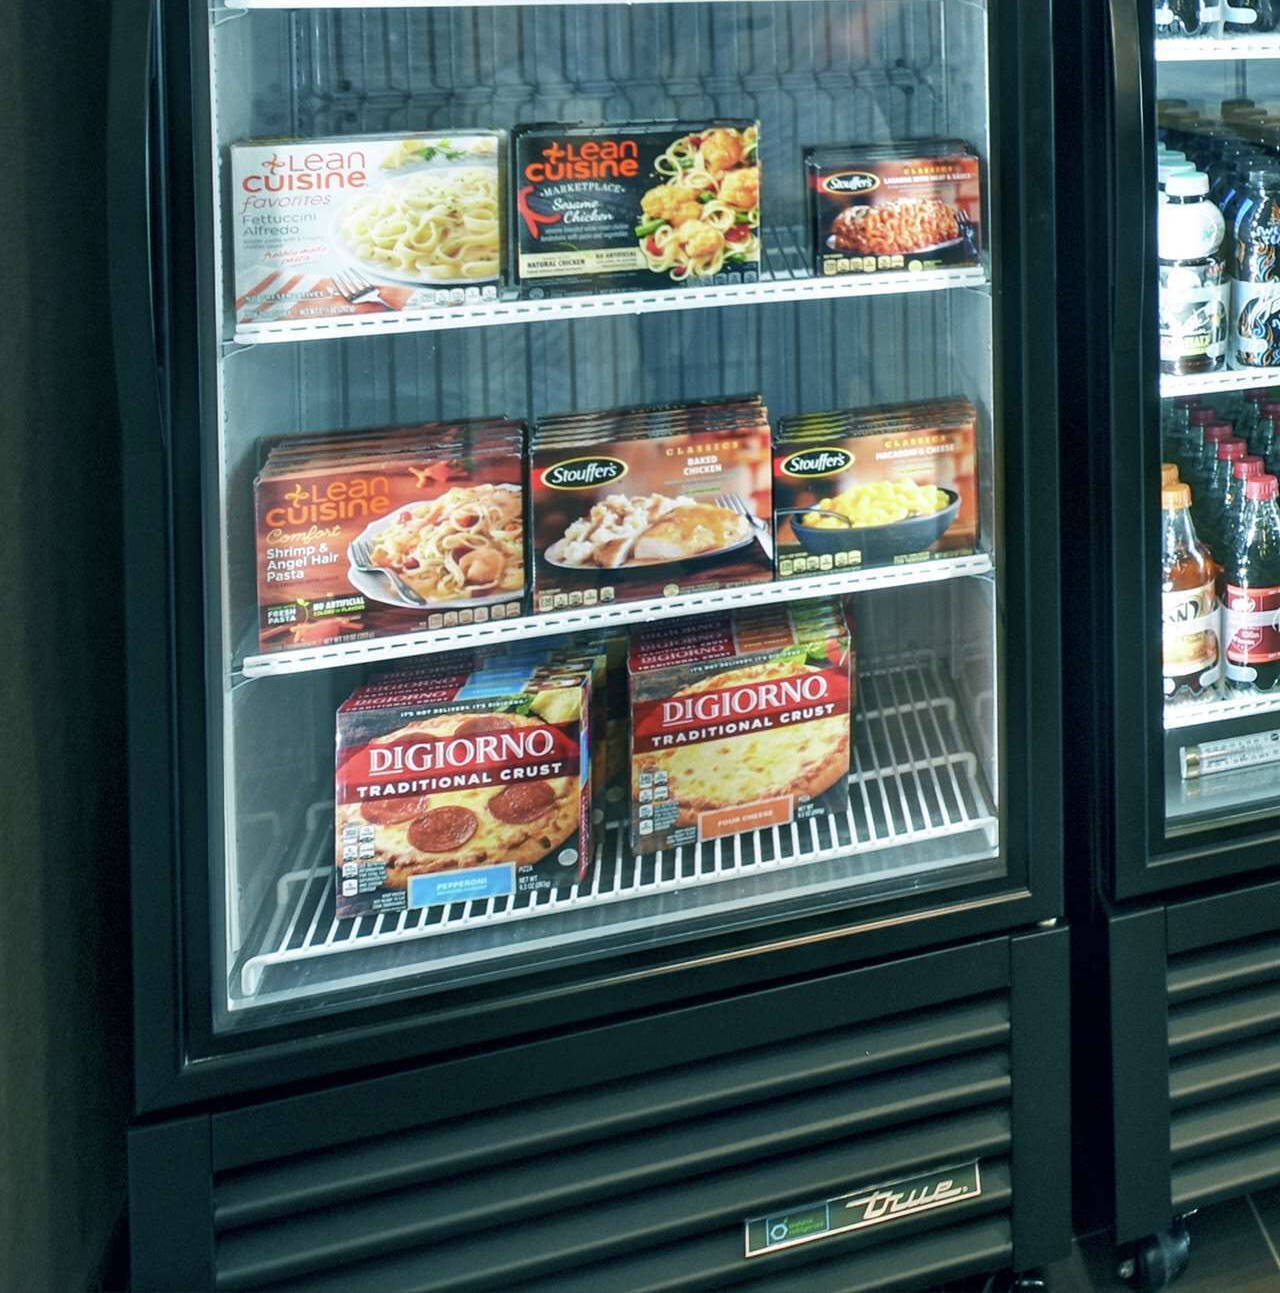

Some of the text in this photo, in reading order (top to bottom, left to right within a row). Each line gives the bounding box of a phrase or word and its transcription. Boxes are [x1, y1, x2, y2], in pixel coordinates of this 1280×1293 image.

[567, 140, 638, 161] Lean
[289, 152, 365, 172] Lean
[543, 182, 622, 197] MARKETPLACE
[242, 194, 333, 214] favorites
[552, 197, 600, 212] Sesame
[243, 213, 317, 225] Fettuccini
[563, 211, 614, 224] Chicken
[243, 225, 299, 236] Alfredo
[683, 464, 723, 475] CHICKEN
[789, 454, 845, 472] Stouffer's
[552, 462, 617, 484] Stouffer's
[312, 476, 388, 503] Lean
[266, 525, 341, 545] Comfort
[267, 543, 328, 560] Shrimp &
[267, 553, 339, 571] Angel Hair
[267, 569, 304, 582] Pasta
[268, 617, 296, 625] PASTA
[641, 645, 724, 664] DIGIORNO
[662, 675, 828, 727] DIGIORNO
[652, 703, 834, 747] TRADITIONAL CRUST
[369, 729, 554, 774] DIGIORNO
[357, 762, 563, 798] TRADITIONAL CRUST
